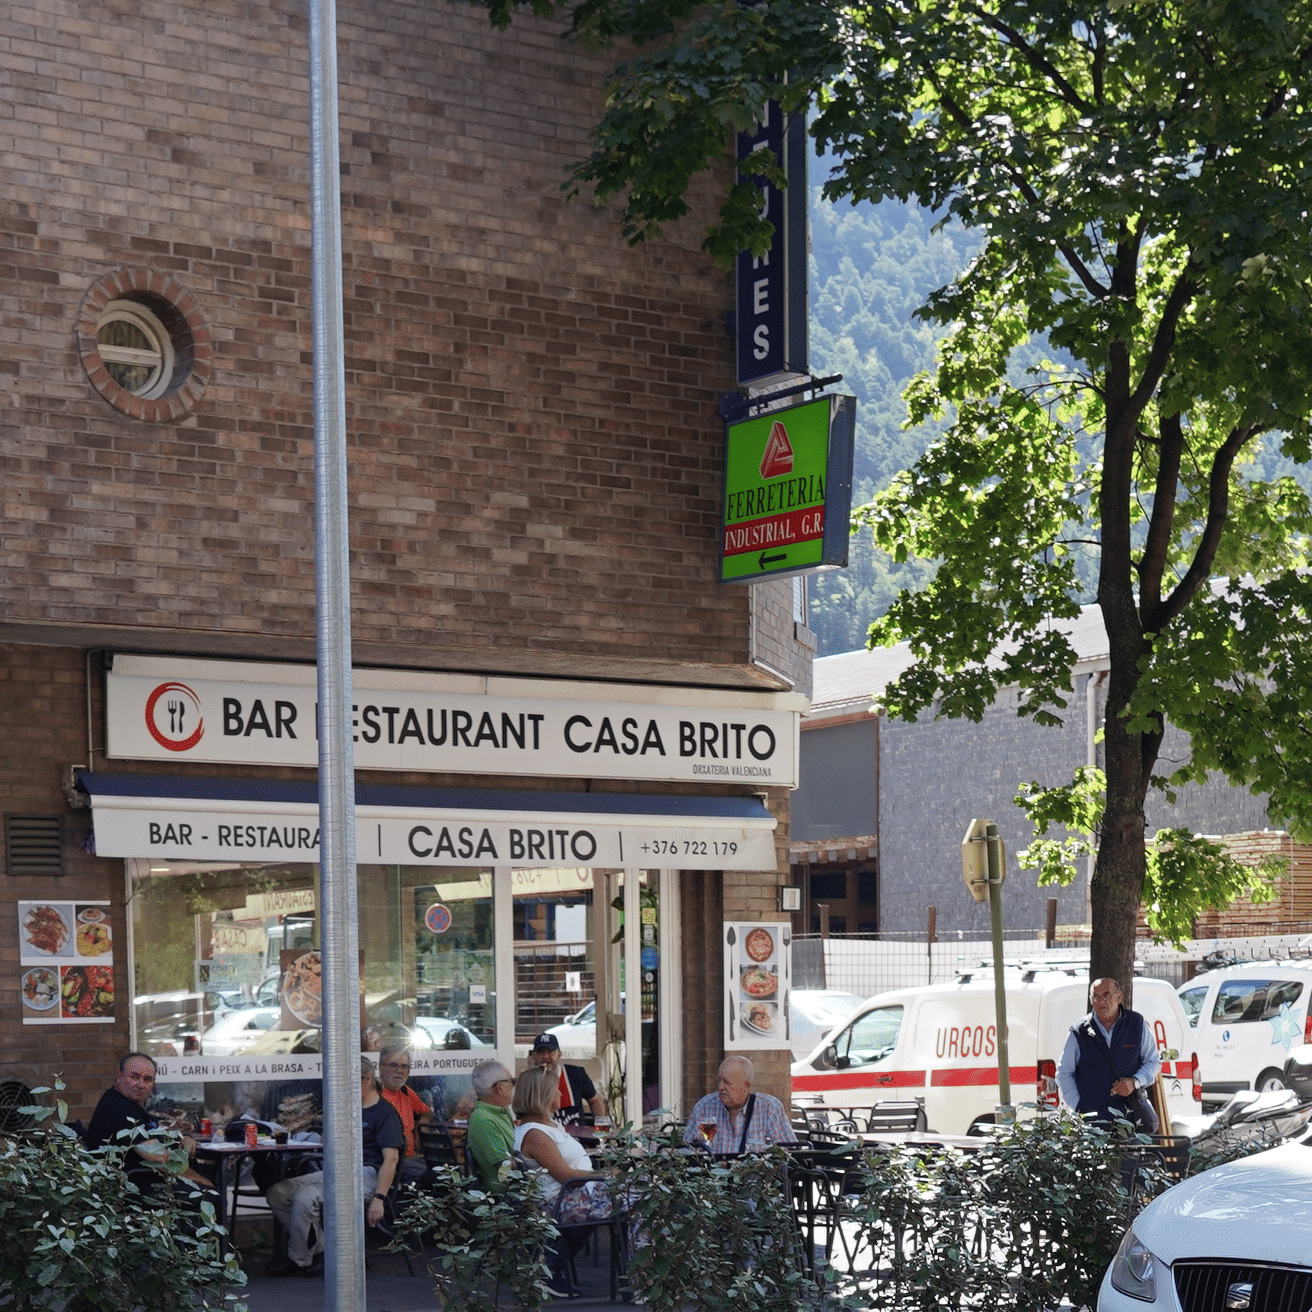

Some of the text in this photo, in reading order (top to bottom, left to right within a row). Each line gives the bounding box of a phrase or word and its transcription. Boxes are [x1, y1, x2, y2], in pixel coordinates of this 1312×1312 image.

[726, 472, 826, 521] FERRETERIA
[724, 511, 825, 552] INDUSTRIAL, G.R.
[222, 697, 298, 740] BAR
[563, 713, 667, 757] CASA
[678, 719, 777, 762] BRITO
[730, 765, 773, 778] VALENCIANA
[148, 822, 195, 848] BAR
[217, 824, 320, 849] RESTAURA
[407, 824, 499, 861] CASA
[509, 828, 598, 862] BRITO
[640, 840, 678, 855] +376
[683, 841, 708, 855] 722
[713, 841, 739, 857] 179
[181, 1065, 209, 1076] CARN
[219, 1065, 241, 1075] PEIX
[244, 1064, 252, 1074] A
[255, 1063, 268, 1074] LA
[271, 1062, 304, 1073] BRASA
